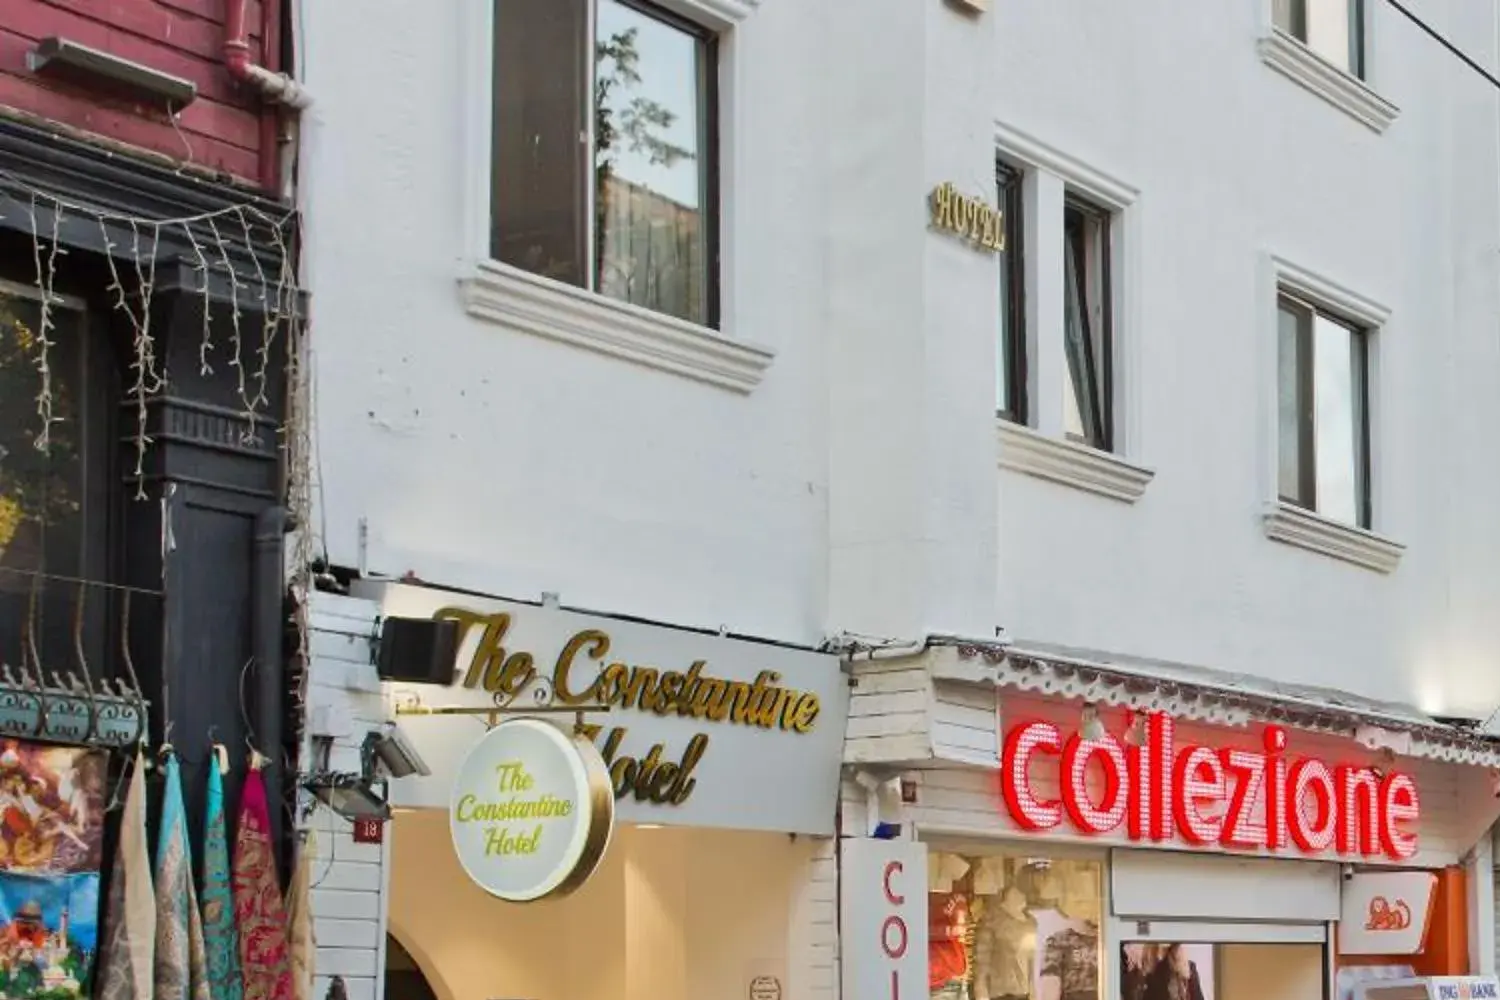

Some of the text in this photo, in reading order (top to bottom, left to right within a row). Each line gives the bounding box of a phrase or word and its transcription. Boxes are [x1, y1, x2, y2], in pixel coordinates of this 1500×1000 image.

[932, 181, 1005, 251] HOTEL
[432, 607, 821, 734] The Constantine
[496, 762, 533, 792] The
[1003, 710, 1418, 859] collezione
[456, 793, 574, 822] Constantine
[484, 826, 542, 856] Hotel
[1470, 982, 1497, 999] BANK
